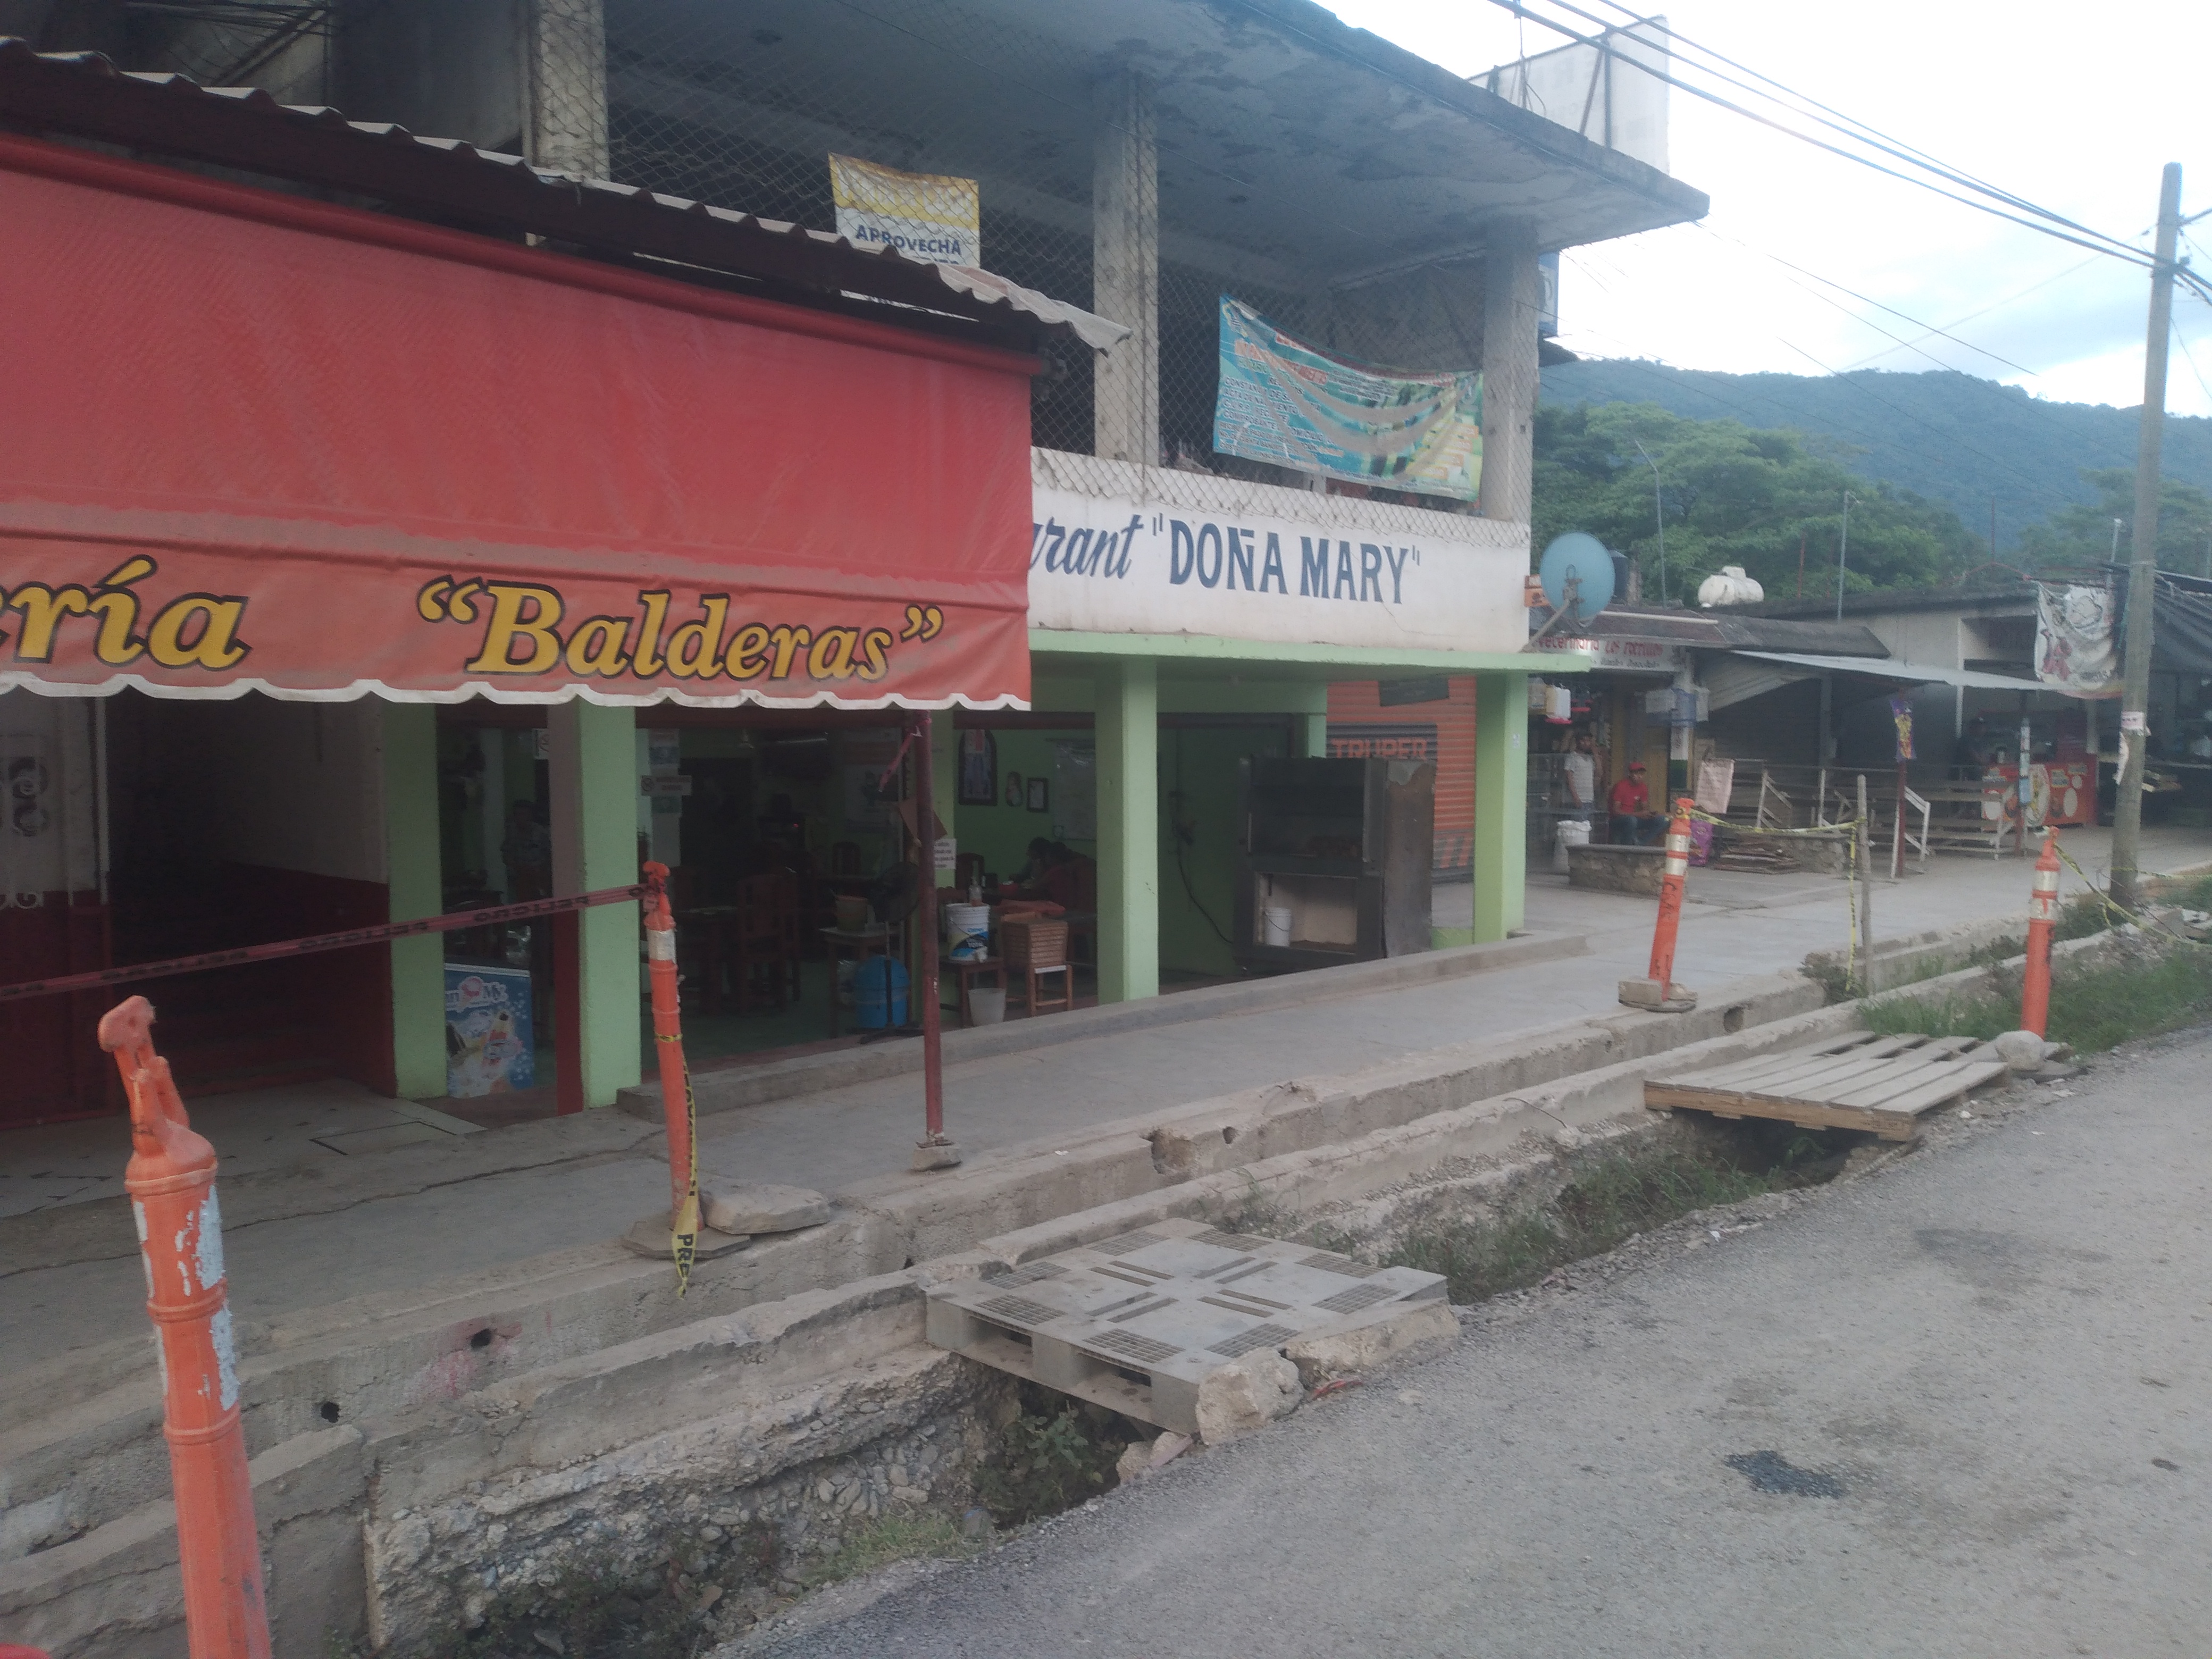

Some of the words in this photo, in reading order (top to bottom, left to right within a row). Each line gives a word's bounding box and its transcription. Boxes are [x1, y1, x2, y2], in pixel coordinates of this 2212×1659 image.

[855, 224, 962, 256] APROVECHA
[1299, 536, 1421, 604] MARY"
[0, 554, 253, 672] ría
